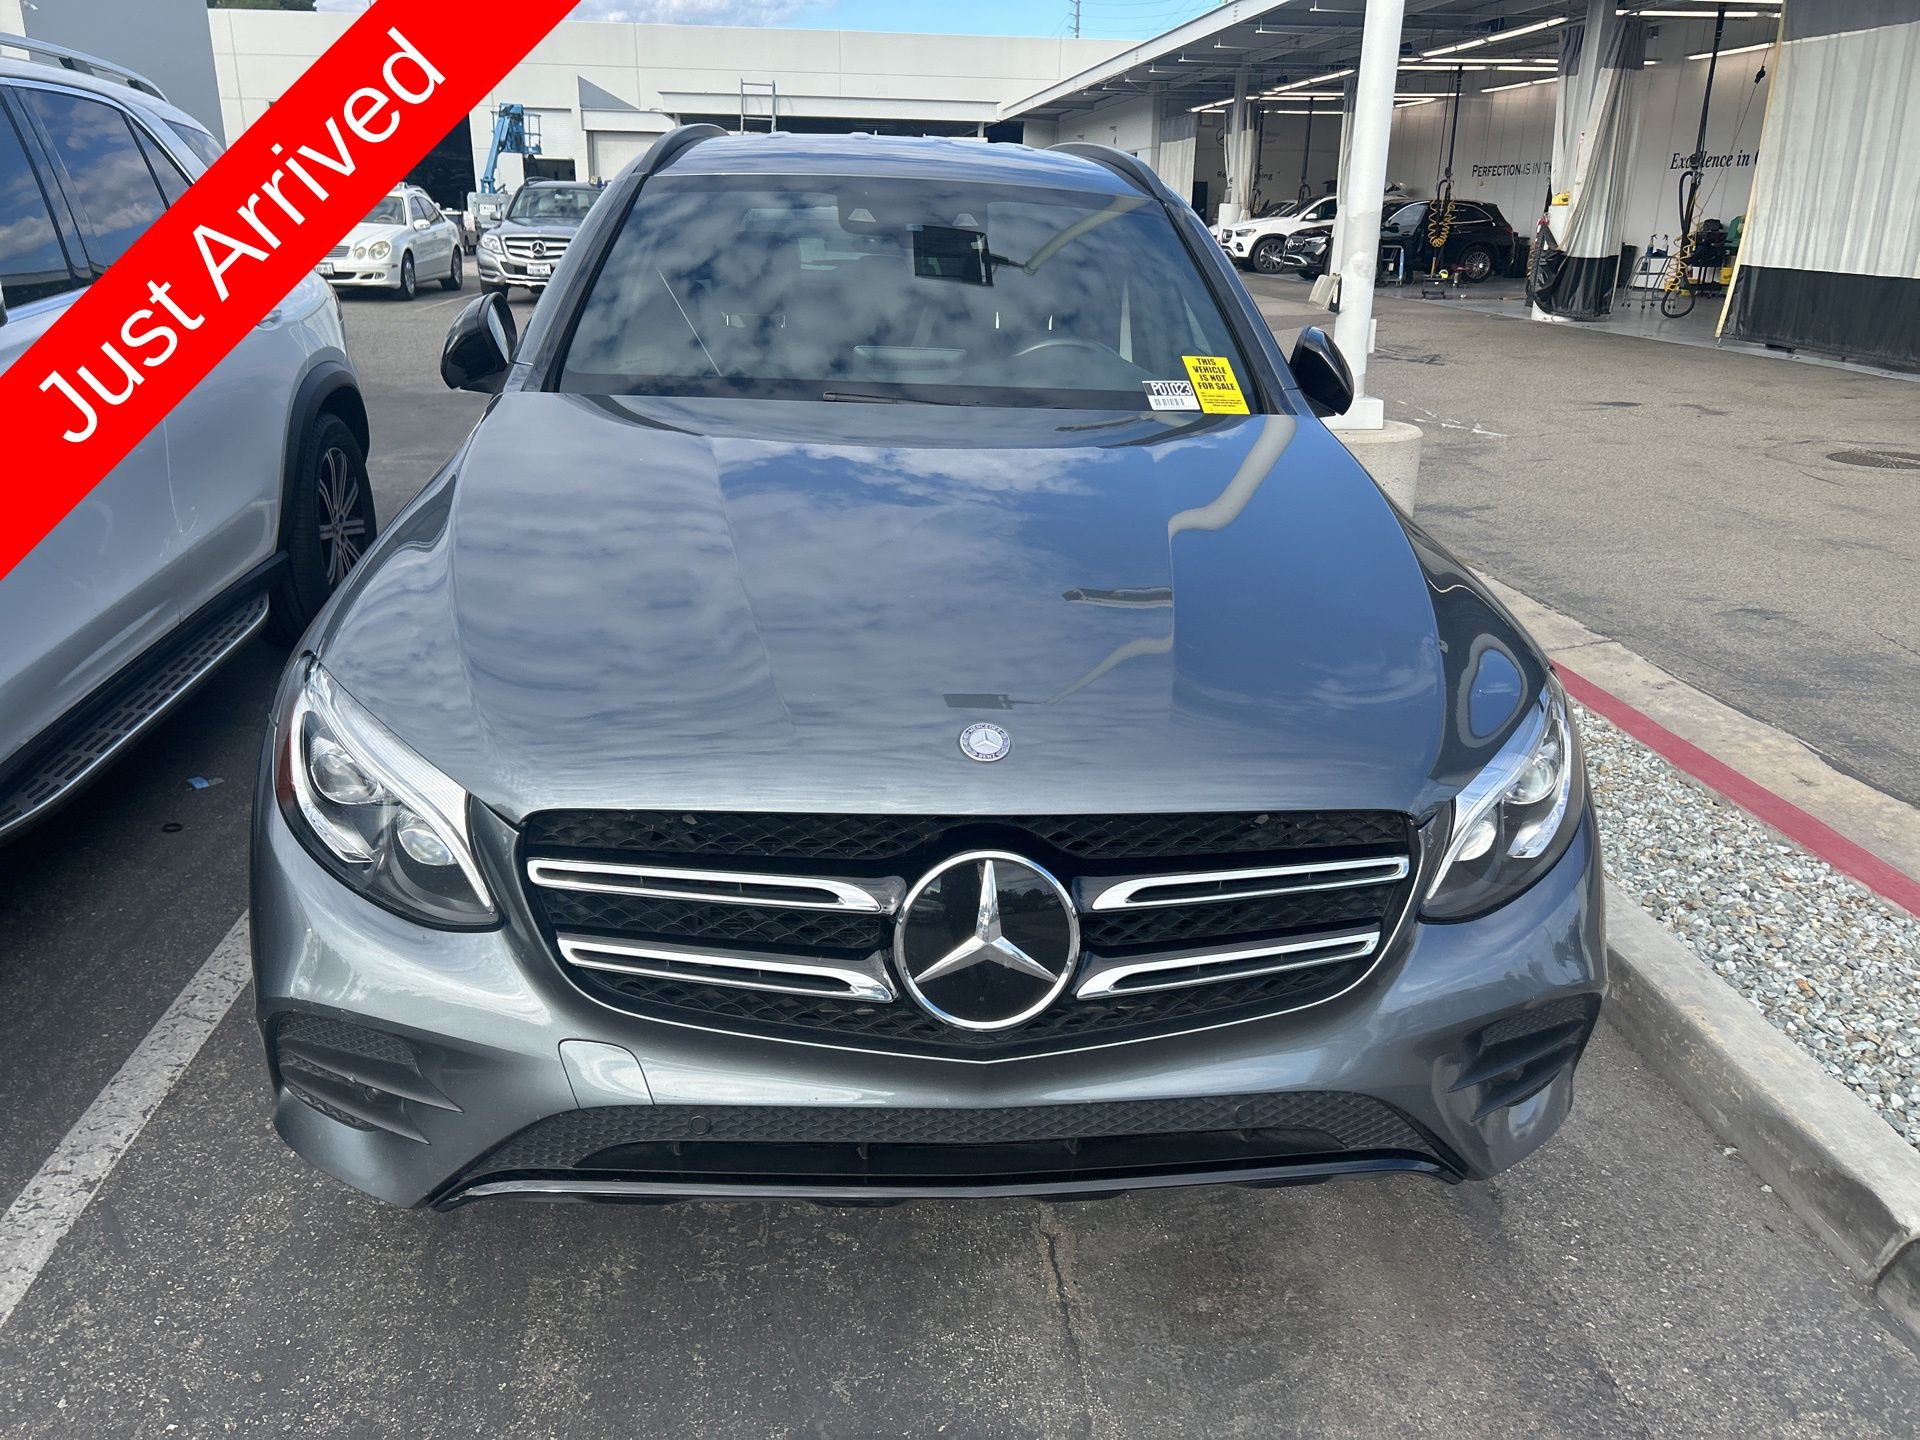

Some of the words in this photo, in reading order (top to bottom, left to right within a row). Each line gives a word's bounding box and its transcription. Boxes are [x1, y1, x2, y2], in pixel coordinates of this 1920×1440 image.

[1736, 149, 1751, 167] in
[1471, 164, 1521, 177] PERFECTION
[1521, 163, 1531, 175] IS
[1532, 162, 1541, 175] IN
[1196, 358, 1217, 366] THIS
[1192, 365, 1227, 375] VEHICLE
[1199, 373, 1209, 382] IS
[1209, 374, 1227, 382] NOT
[1197, 381, 1215, 390] FOR
[1214, 382, 1236, 391] SALE
